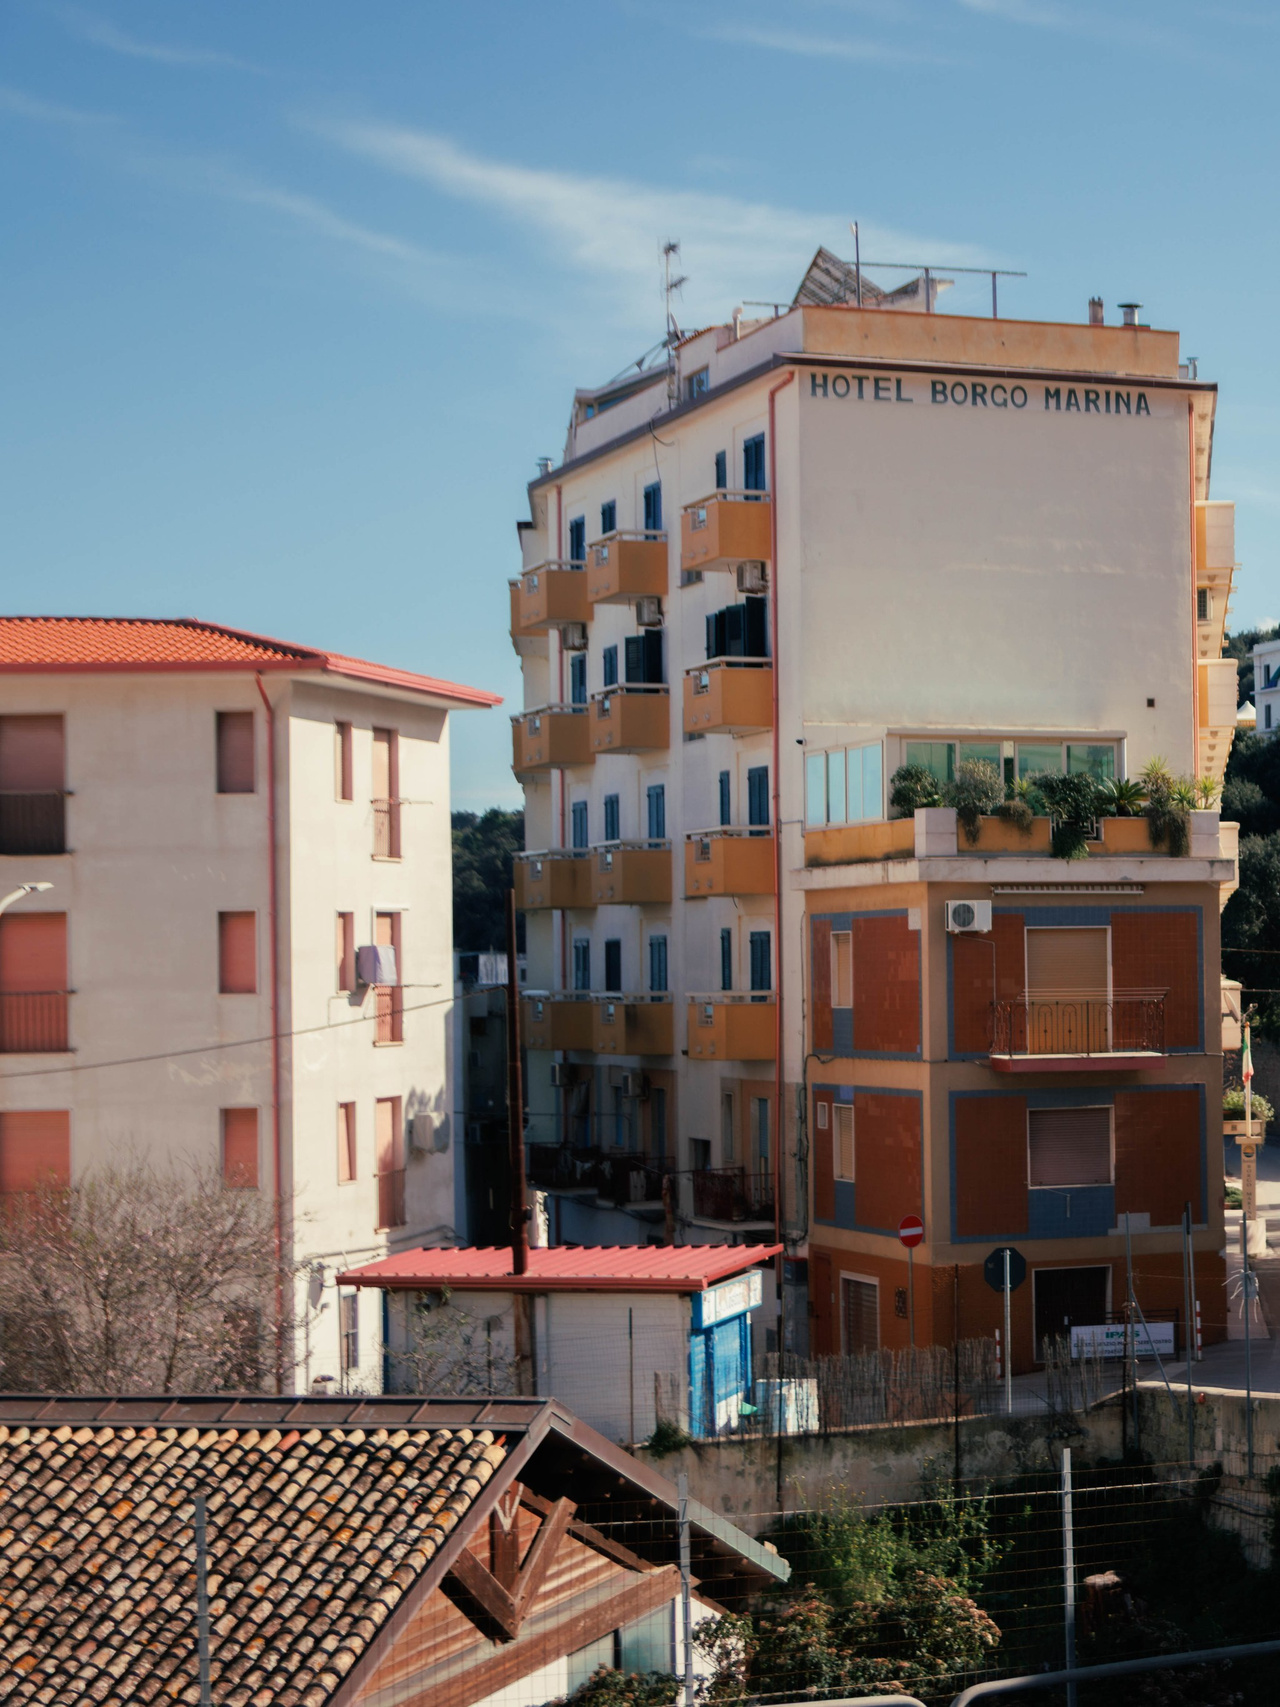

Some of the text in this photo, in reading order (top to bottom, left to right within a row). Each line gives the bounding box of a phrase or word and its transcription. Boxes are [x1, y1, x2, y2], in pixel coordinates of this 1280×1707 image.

[810, 372, 1151, 416] HOTEL BORGO MARINA
